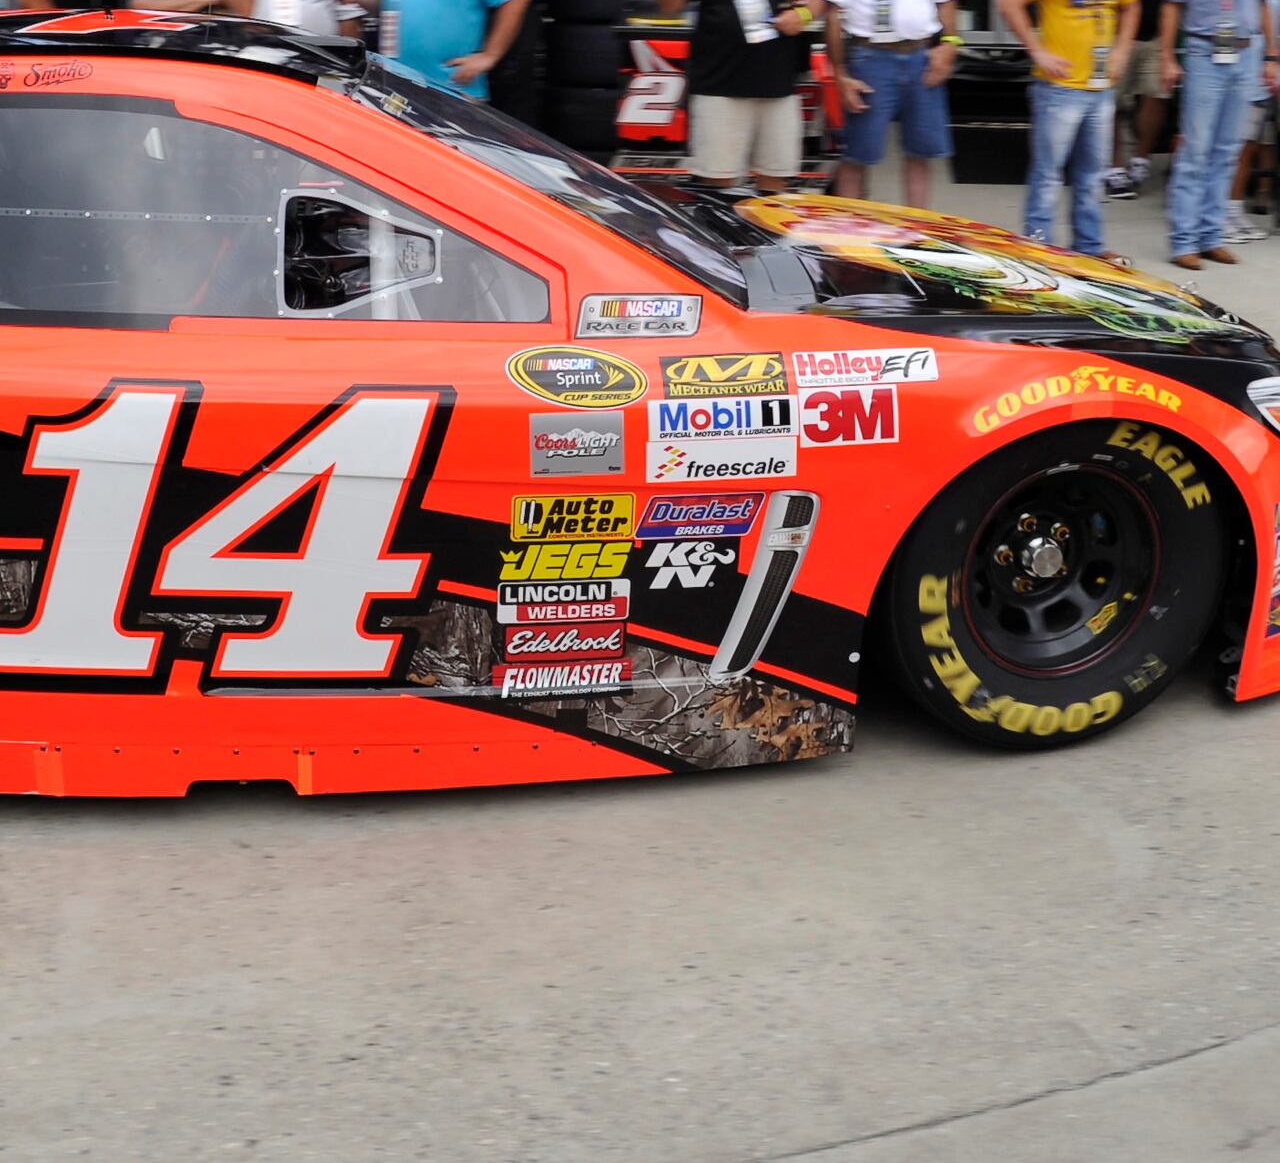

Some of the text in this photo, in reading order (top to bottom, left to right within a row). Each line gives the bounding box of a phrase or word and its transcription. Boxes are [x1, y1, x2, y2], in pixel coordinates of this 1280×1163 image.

[624, 300, 679, 317] NASCAR
[586, 321, 686, 332] RACE CAR
[547, 358, 593, 371] NASCAR
[795, 350, 931, 381] Holley EFI
[556, 372, 602, 388] Sprint
[669, 379, 786, 397] MECHANIX WEAR
[563, 392, 632, 401] CUP SERIES
[973, 365, 1183, 434] GOODYEAR
[659, 400, 751, 432] Mobil
[803, 388, 895, 444] 3M
[534, 433, 620, 450] Coors LIGHT
[694, 430, 722, 438] MOTOR
[745, 427, 791, 436] LUBRICANTS
[547, 447, 607, 458] POLE
[686, 457, 786, 478] freescale
[1106, 421, 1212, 511] EAGLE
[548, 497, 614, 516] Auto
[649, 499, 755, 523] Duralast
[541, 516, 628, 535] Meter
[675, 524, 725, 536] BRAKES
[500, 542, 633, 580] JEGS
[505, 583, 606, 603] LINCOLN
[527, 604, 616, 620] WELDERS
[507, 628, 621, 654] Edelbrock
[919, 573, 1124, 736] GOODYEAR
[501, 663, 623, 698] FLOWMASTER
